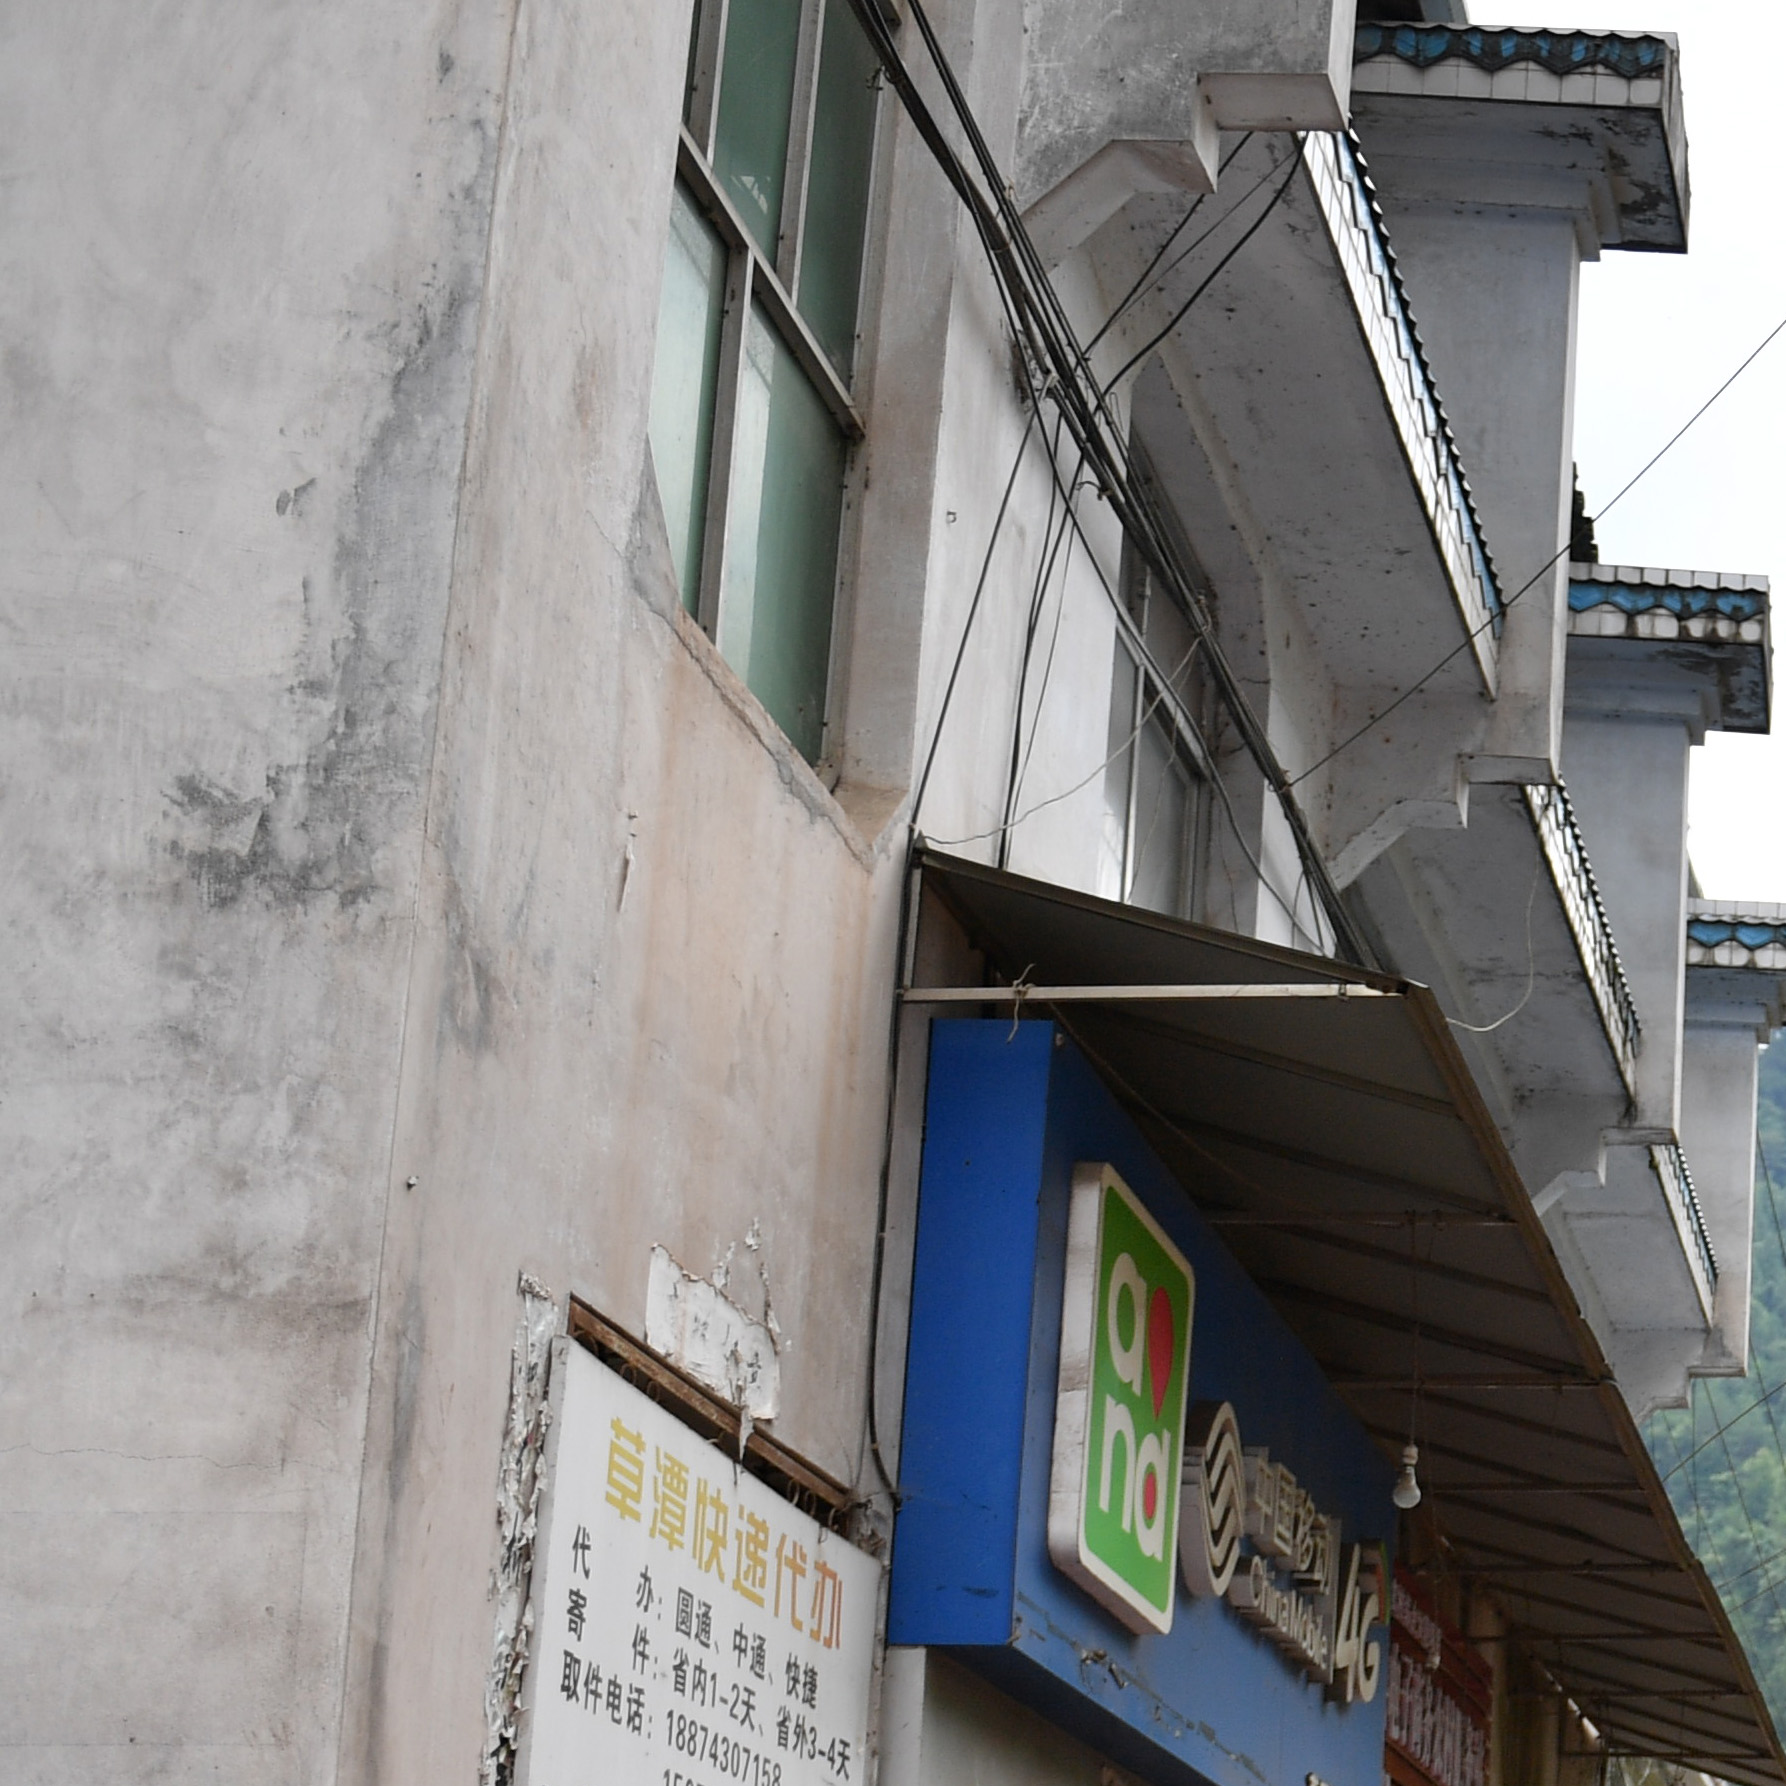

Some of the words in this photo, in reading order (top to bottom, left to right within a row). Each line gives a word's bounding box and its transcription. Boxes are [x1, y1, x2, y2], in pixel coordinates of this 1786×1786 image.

[604, 1416, 843, 1650] 草潭快递代办
[1254, 1456, 1332, 1596] 中国移动
[1336, 1542, 1381, 1703] 4G
